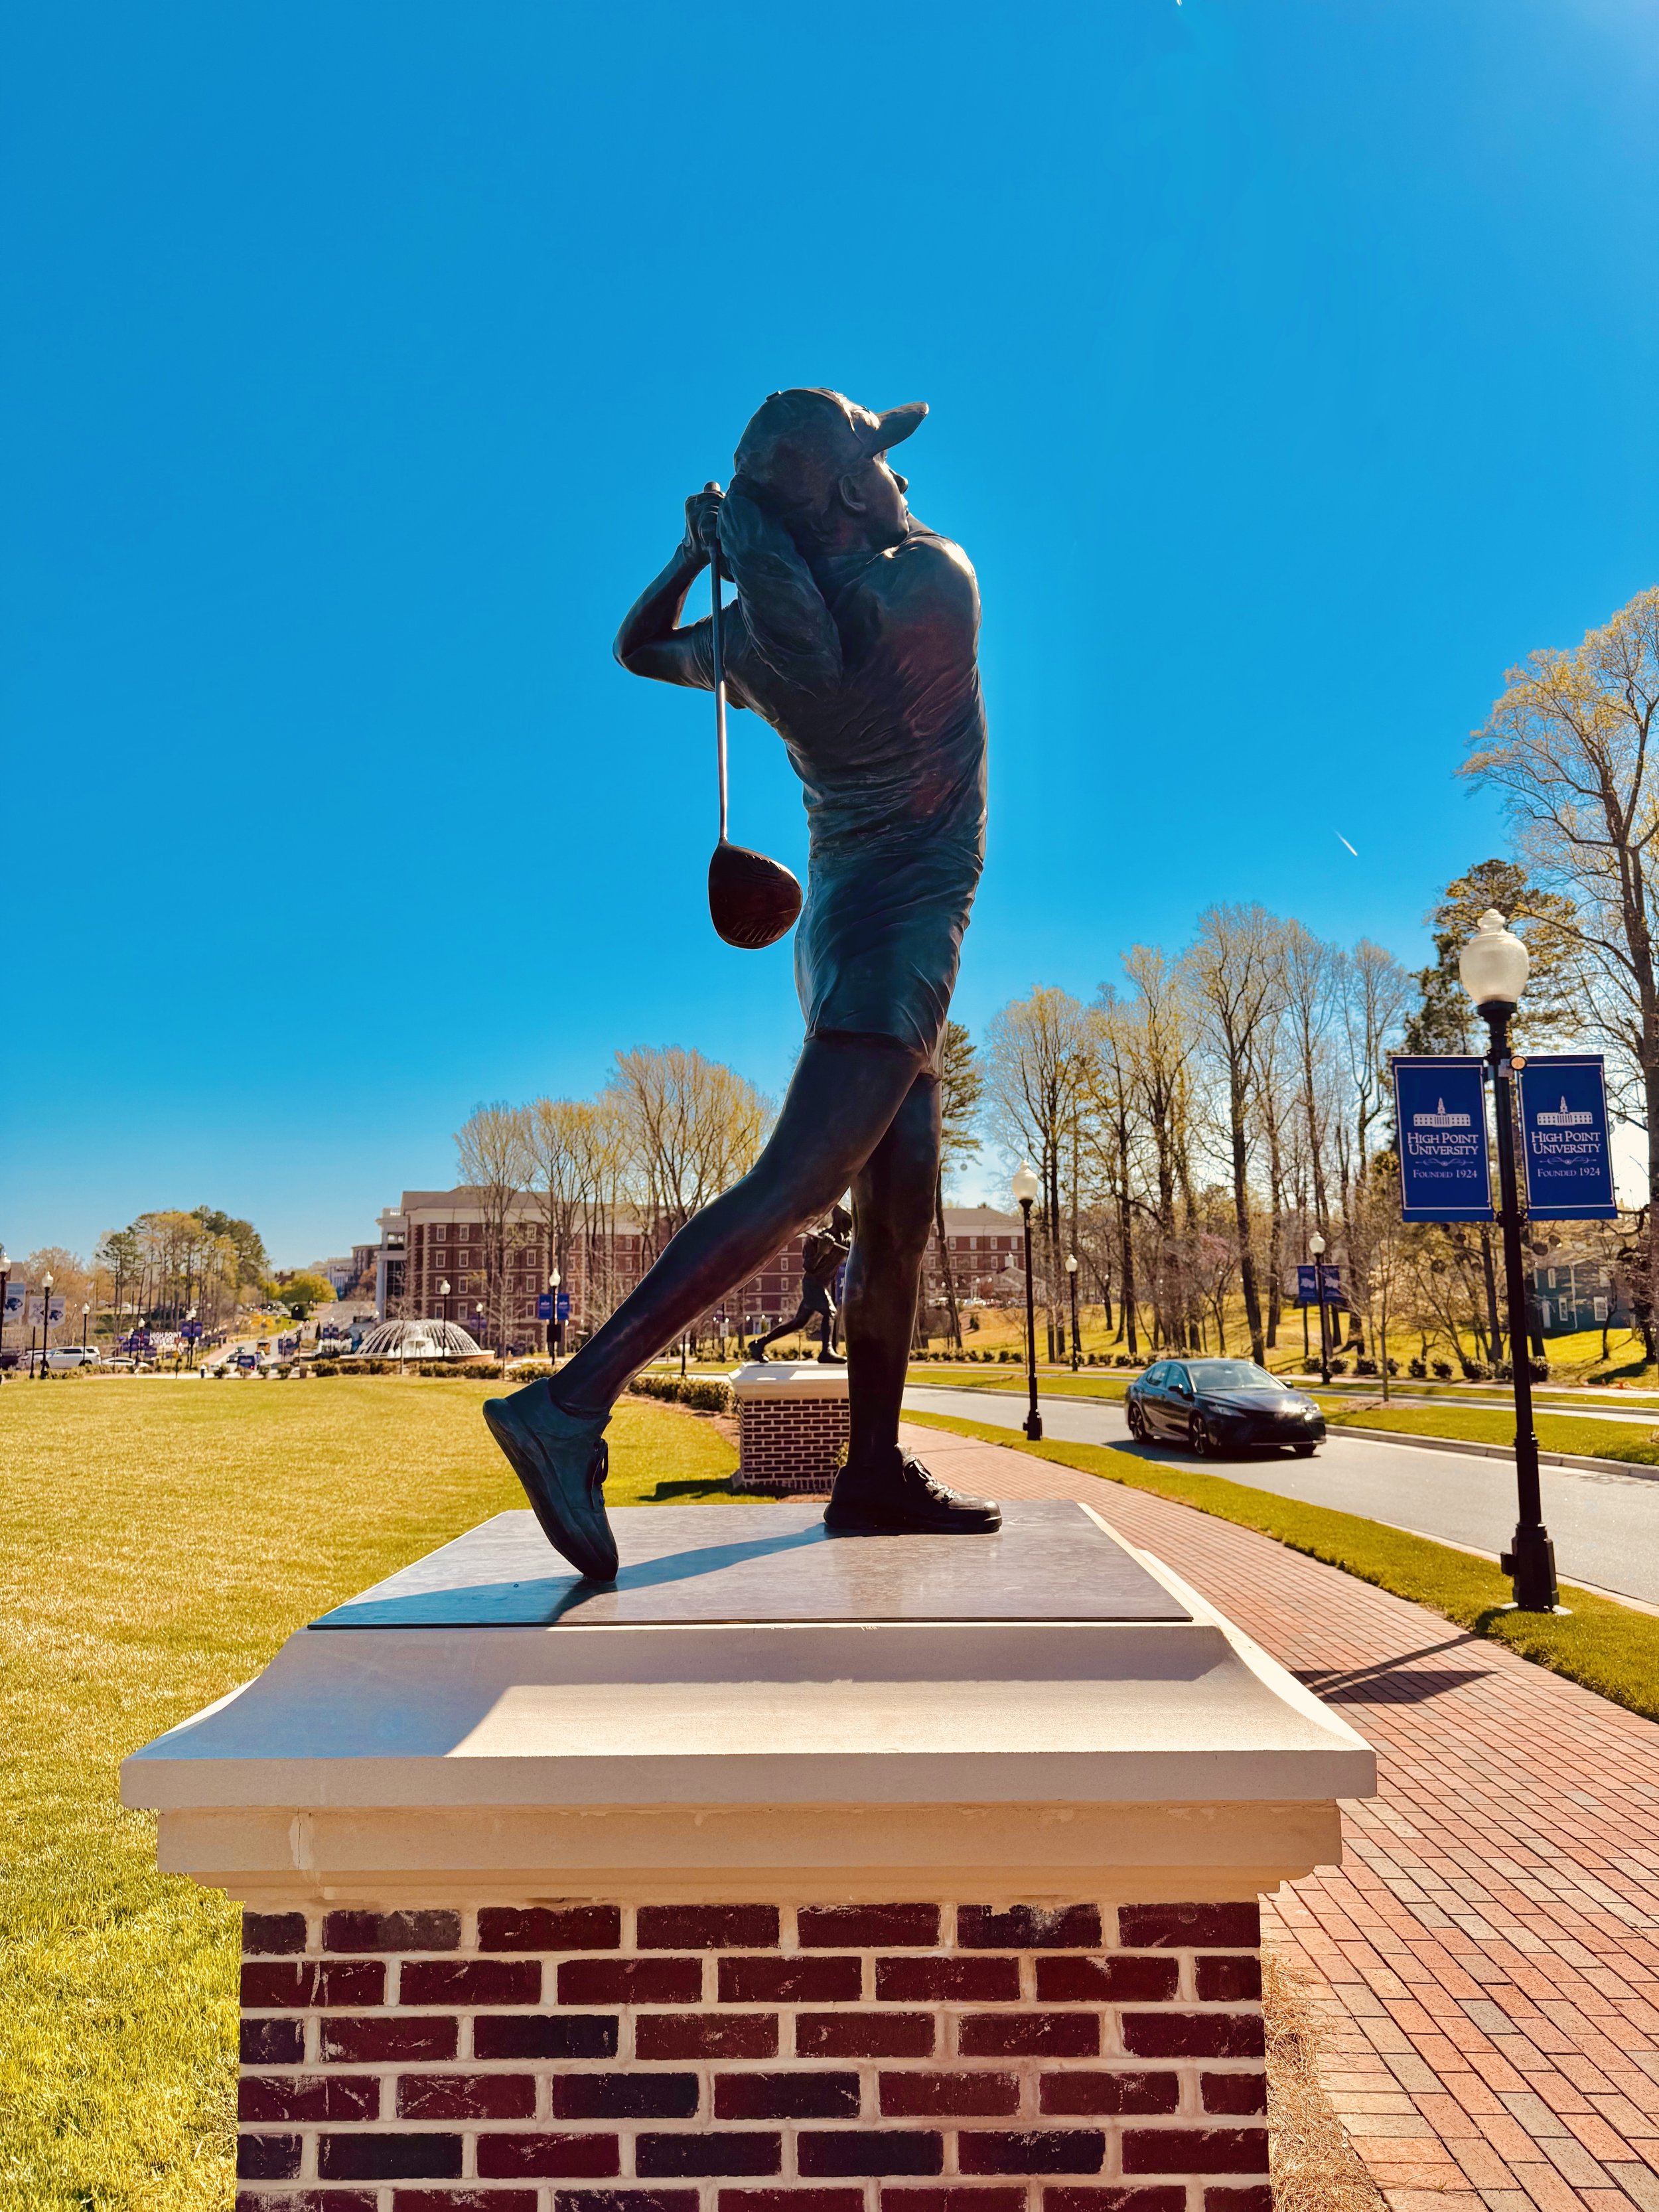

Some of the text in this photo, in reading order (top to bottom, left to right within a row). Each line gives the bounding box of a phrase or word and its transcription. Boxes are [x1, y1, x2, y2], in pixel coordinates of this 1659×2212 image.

[1407, 1132, 1479, 1143] HIGH POINT
[1531, 1130, 1601, 1143] HIGH POINT
[1408, 1144, 1479, 1155] UNIVERSITY
[1532, 1143, 1601, 1154] UNIVERSITY
[1413, 1169, 1477, 1178] FOUNDED 1924
[1538, 1167, 1601, 1177] FOUNDED 1924
